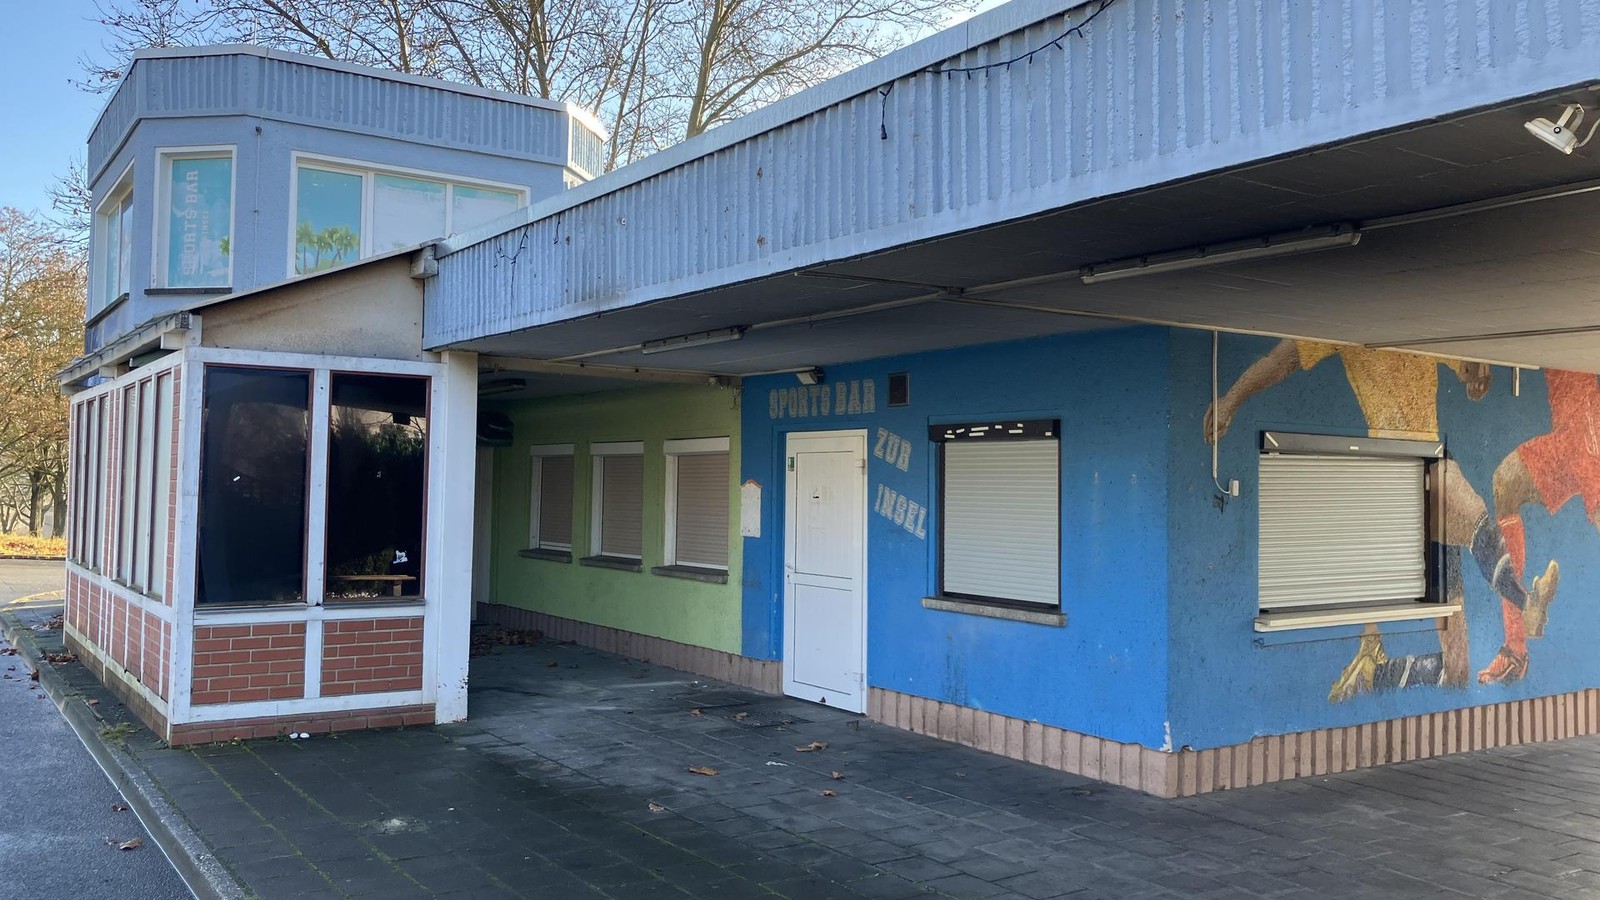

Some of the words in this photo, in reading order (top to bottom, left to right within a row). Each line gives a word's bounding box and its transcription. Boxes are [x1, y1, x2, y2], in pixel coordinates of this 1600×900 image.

[185, 169, 199, 203] BAR
[183, 208, 198, 275] SPORTS
[769, 384, 831, 419] SPORTS
[835, 379, 876, 415] BAR
[873, 427, 912, 472] ZUR
[873, 483, 927, 540] INSEL
